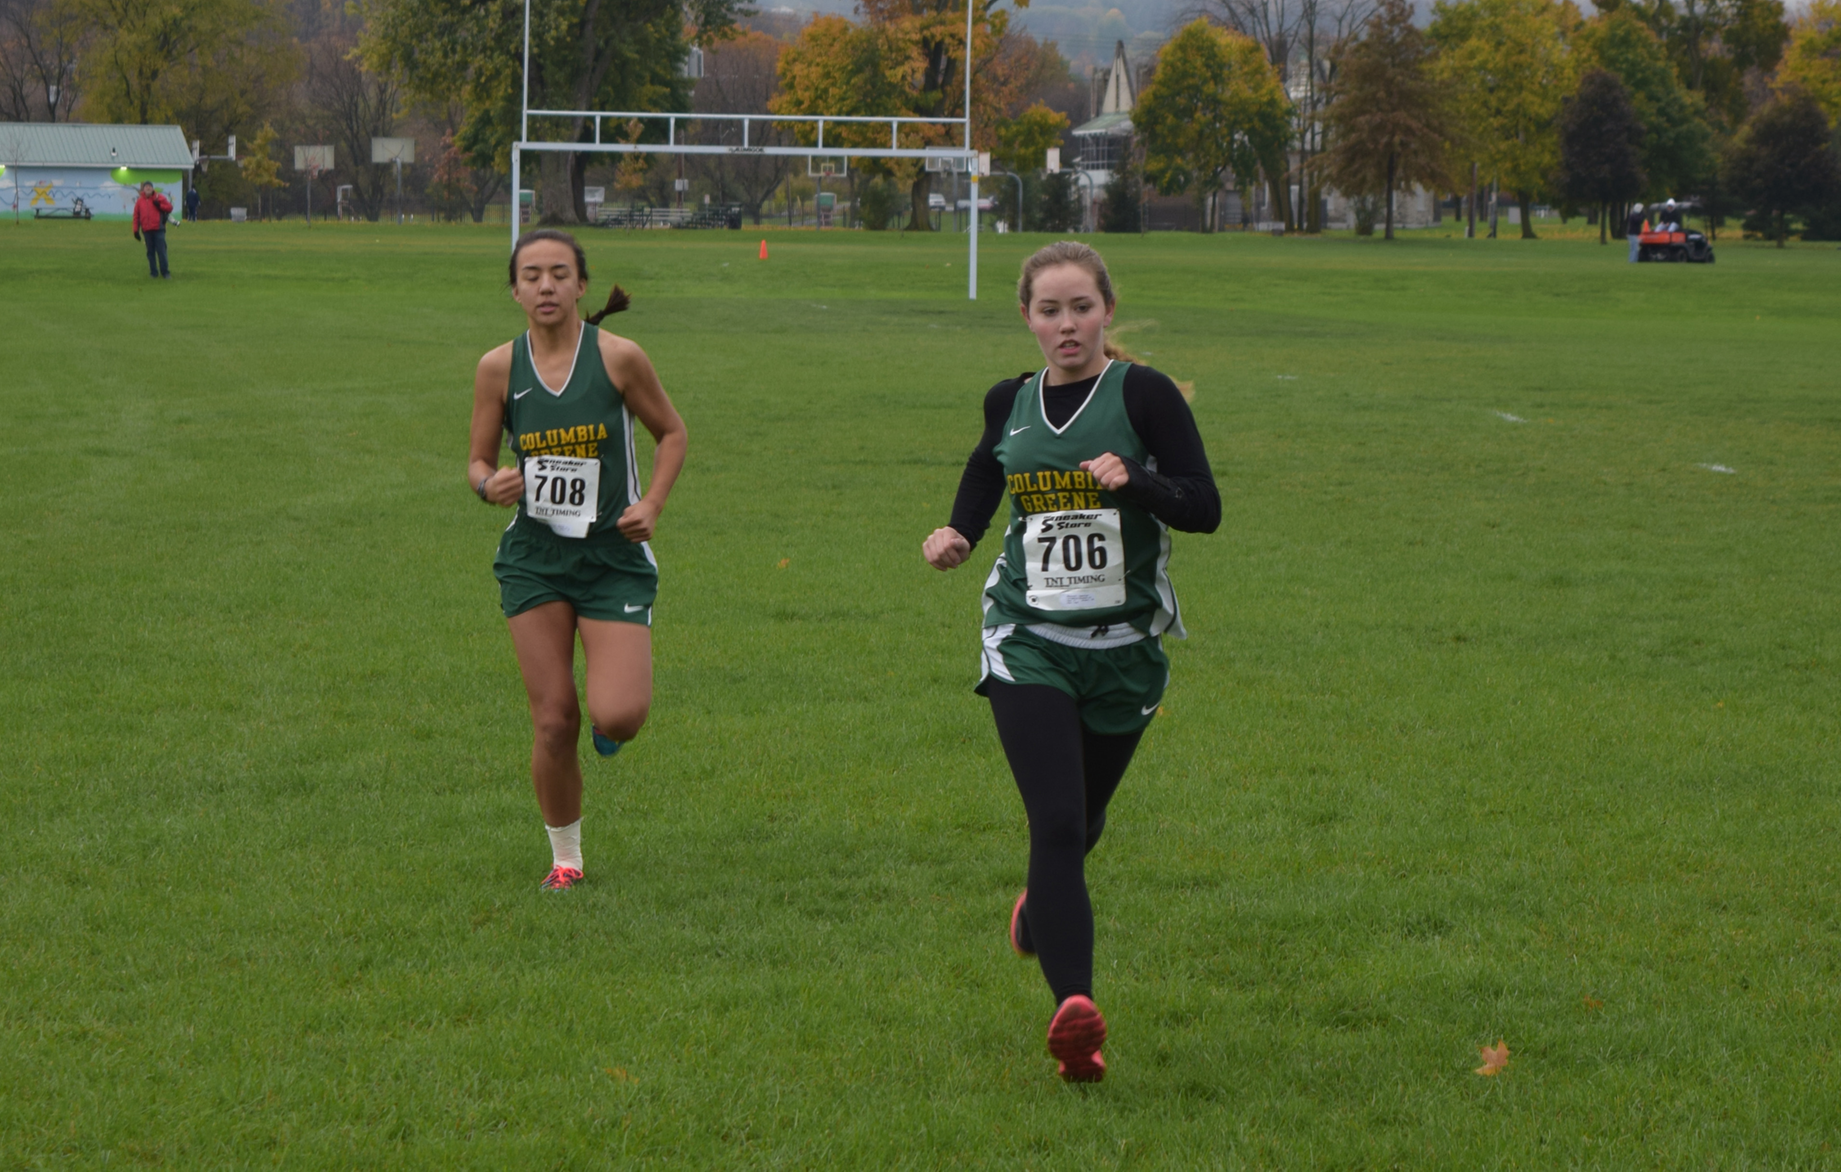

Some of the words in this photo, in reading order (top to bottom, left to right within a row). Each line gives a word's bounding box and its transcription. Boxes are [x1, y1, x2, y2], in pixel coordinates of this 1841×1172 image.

[519, 422, 608, 451] COLUMBIA
[534, 474, 586, 506] 708
[1007, 470, 1103, 495] COLUMBI
[551, 508, 581, 517] TIMING
[1020, 491, 1102, 513] GREENE
[1041, 513, 1103, 533] Sneaker
[1057, 521, 1092, 531] Store
[1037, 533, 1108, 572] 706
[1044, 577, 1065, 586] TNT
[1066, 574, 1106, 585] TIMING
